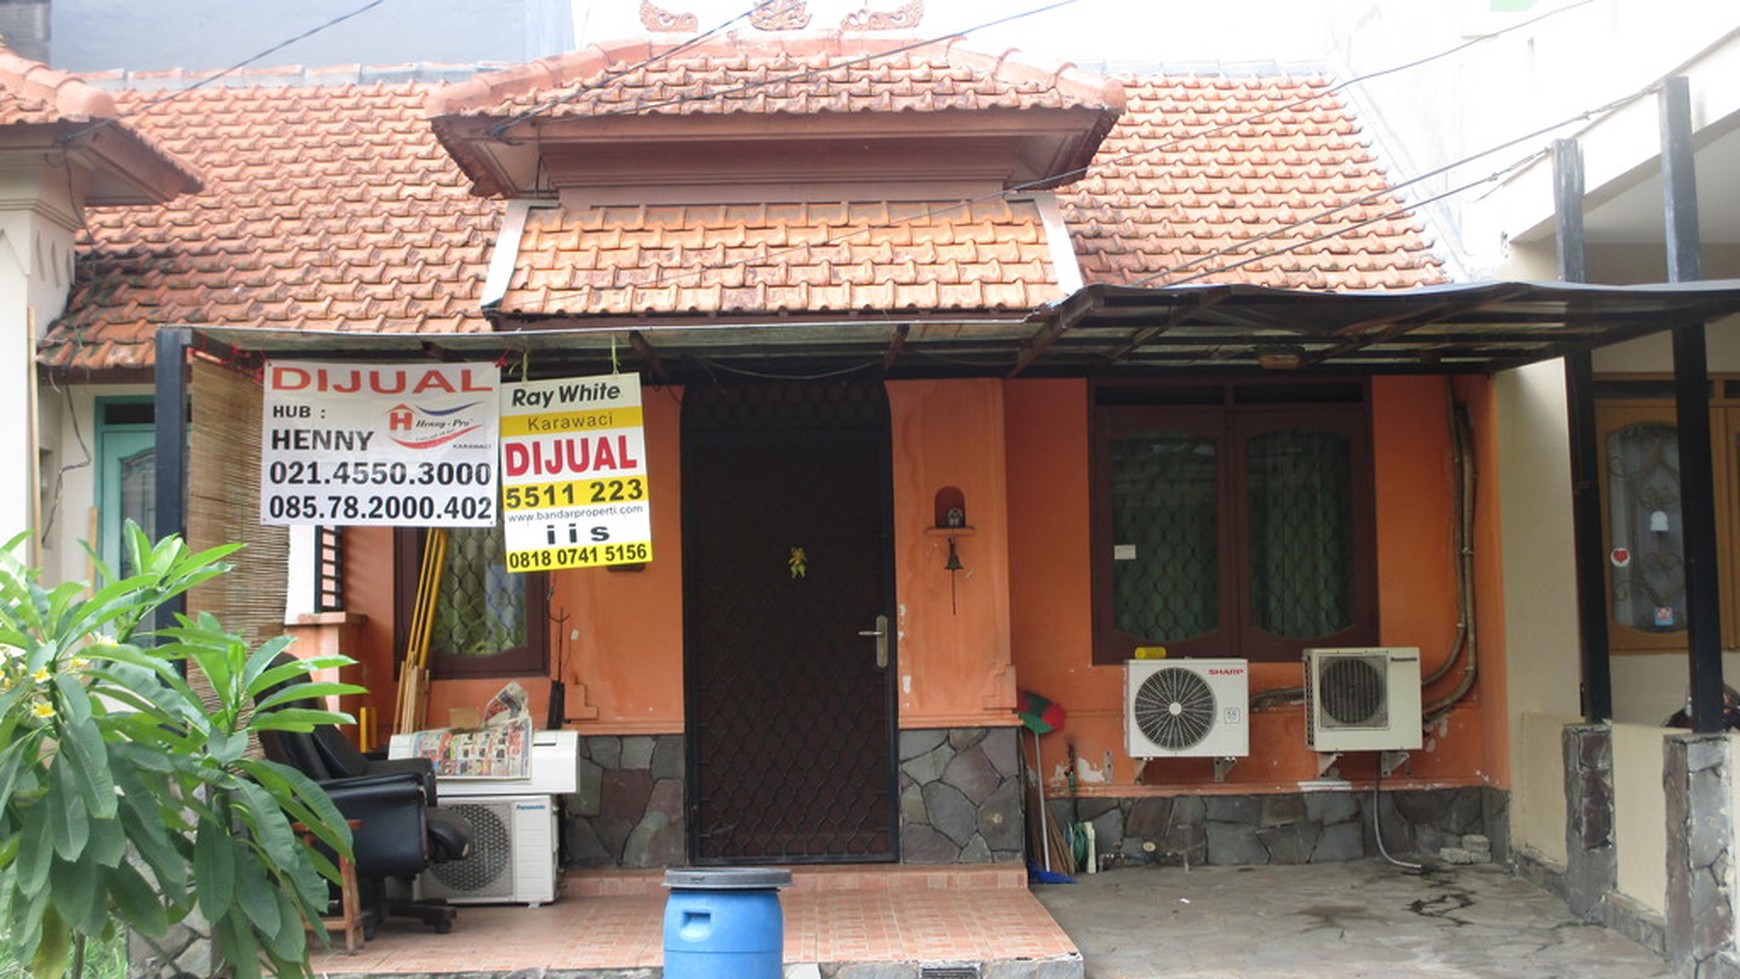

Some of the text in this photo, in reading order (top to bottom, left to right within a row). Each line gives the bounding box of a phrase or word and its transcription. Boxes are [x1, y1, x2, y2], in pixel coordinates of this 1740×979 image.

[272, 366, 493, 394] DIJUAL
[512, 382, 620, 408] Ray White
[273, 405, 311, 418] HUB
[527, 411, 613, 431] Karawaci
[272, 429, 374, 451] HENNY
[505, 435, 637, 476] DIJUAL
[269, 461, 492, 485] 021.4550.3000
[506, 479, 643, 508] 5511 223
[269, 496, 492, 519] 085.78.2000.402
[508, 505, 643, 522] www.bandarproperti.com
[509, 543, 647, 569] 0818 0741 5156
